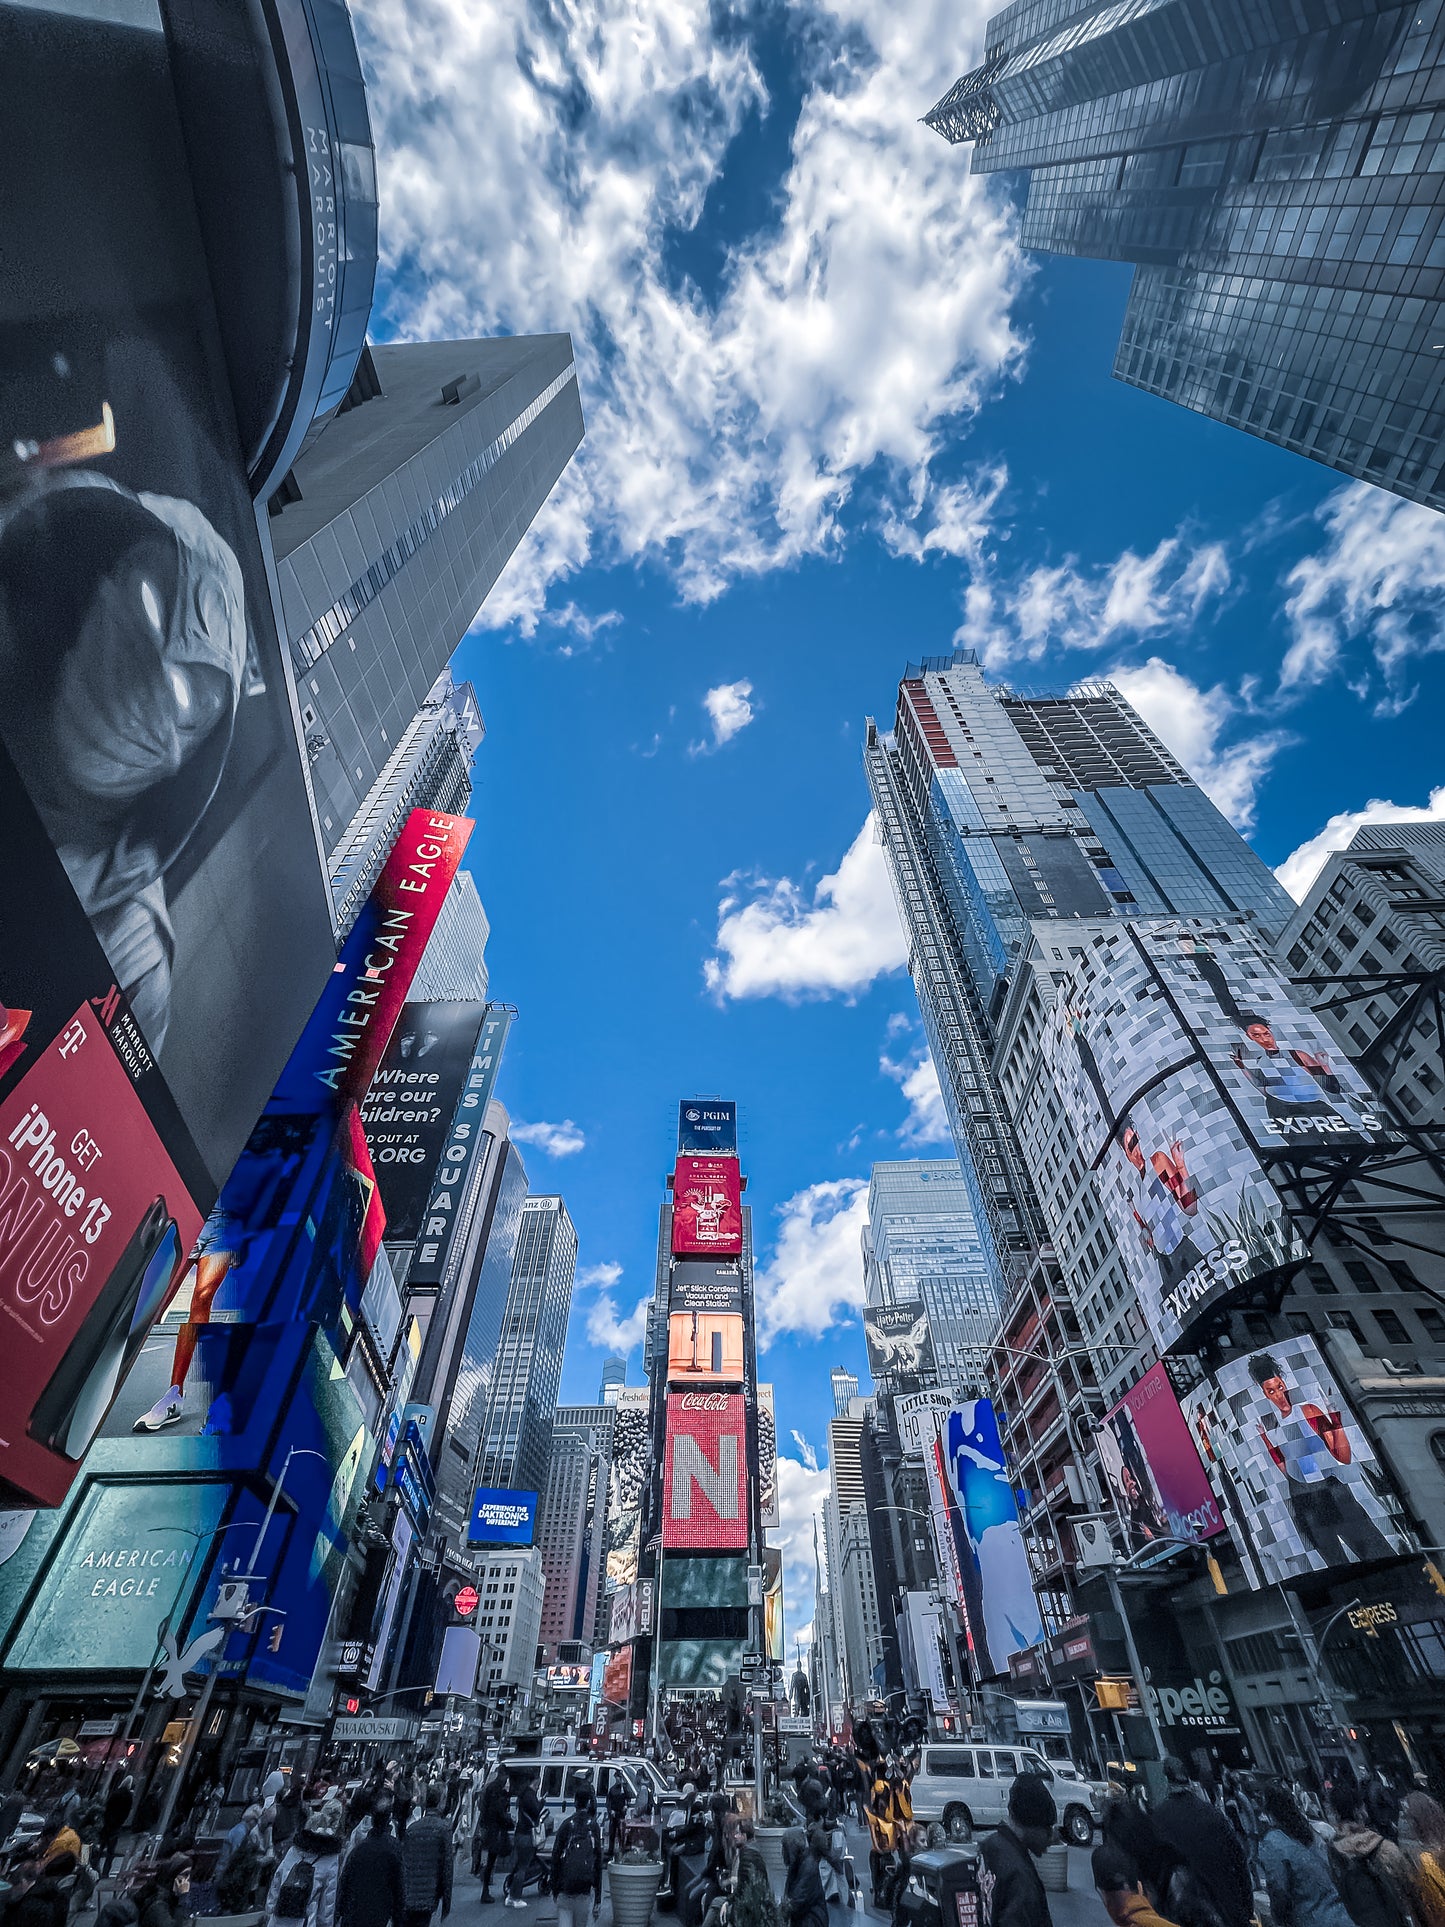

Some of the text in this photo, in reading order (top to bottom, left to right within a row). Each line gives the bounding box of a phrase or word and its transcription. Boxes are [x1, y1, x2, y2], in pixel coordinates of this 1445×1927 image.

[306, 126, 325, 312] MARQUIS
[318, 128, 336, 331] MARRIOTT
[312, 816, 455, 1090] AMERICAN EAGLE
[112, 1025, 143, 1078] MARQUIS
[121, 1013, 153, 1071] MARRIOTT
[373, 1070, 440, 1084] Where
[364, 1091, 437, 1103] are our
[703, 1111, 730, 1121] PGIM
[1260, 1113, 1383, 1135] EXPRESS
[377, 1134, 403, 1143] OUT
[404, 1134, 420, 1143] AT
[418, 1021, 500, 1263] TIMES SQUARE
[70, 1128, 103, 1172] GET
[8, 1103, 112, 1244] iPhone 13
[16, 1218, 89, 1325] US
[1160, 1239, 1249, 1321] EXPRESS
[685, 1292, 714, 1300] Vacuum
[690, 1284, 708, 1292] Stick
[708, 1285, 739, 1293] Cordless
[876, 1312, 895, 1329] Harry
[894, 1311, 914, 1325] Potter
[901, 1393, 952, 1415] LITTLE SHOP
[671, 1434, 739, 1519] N
[478, 1510, 529, 1521] DAKTRONICS
[482, 1503, 528, 1513] EXPERIENCE THE
[486, 1518, 519, 1527] DIFFERENCE
[79, 1549, 193, 1597] AMERICAN EAGLE
[334, 1722, 396, 1735] SWAROVSKI
[1181, 1716, 1227, 1726] SOCCER
